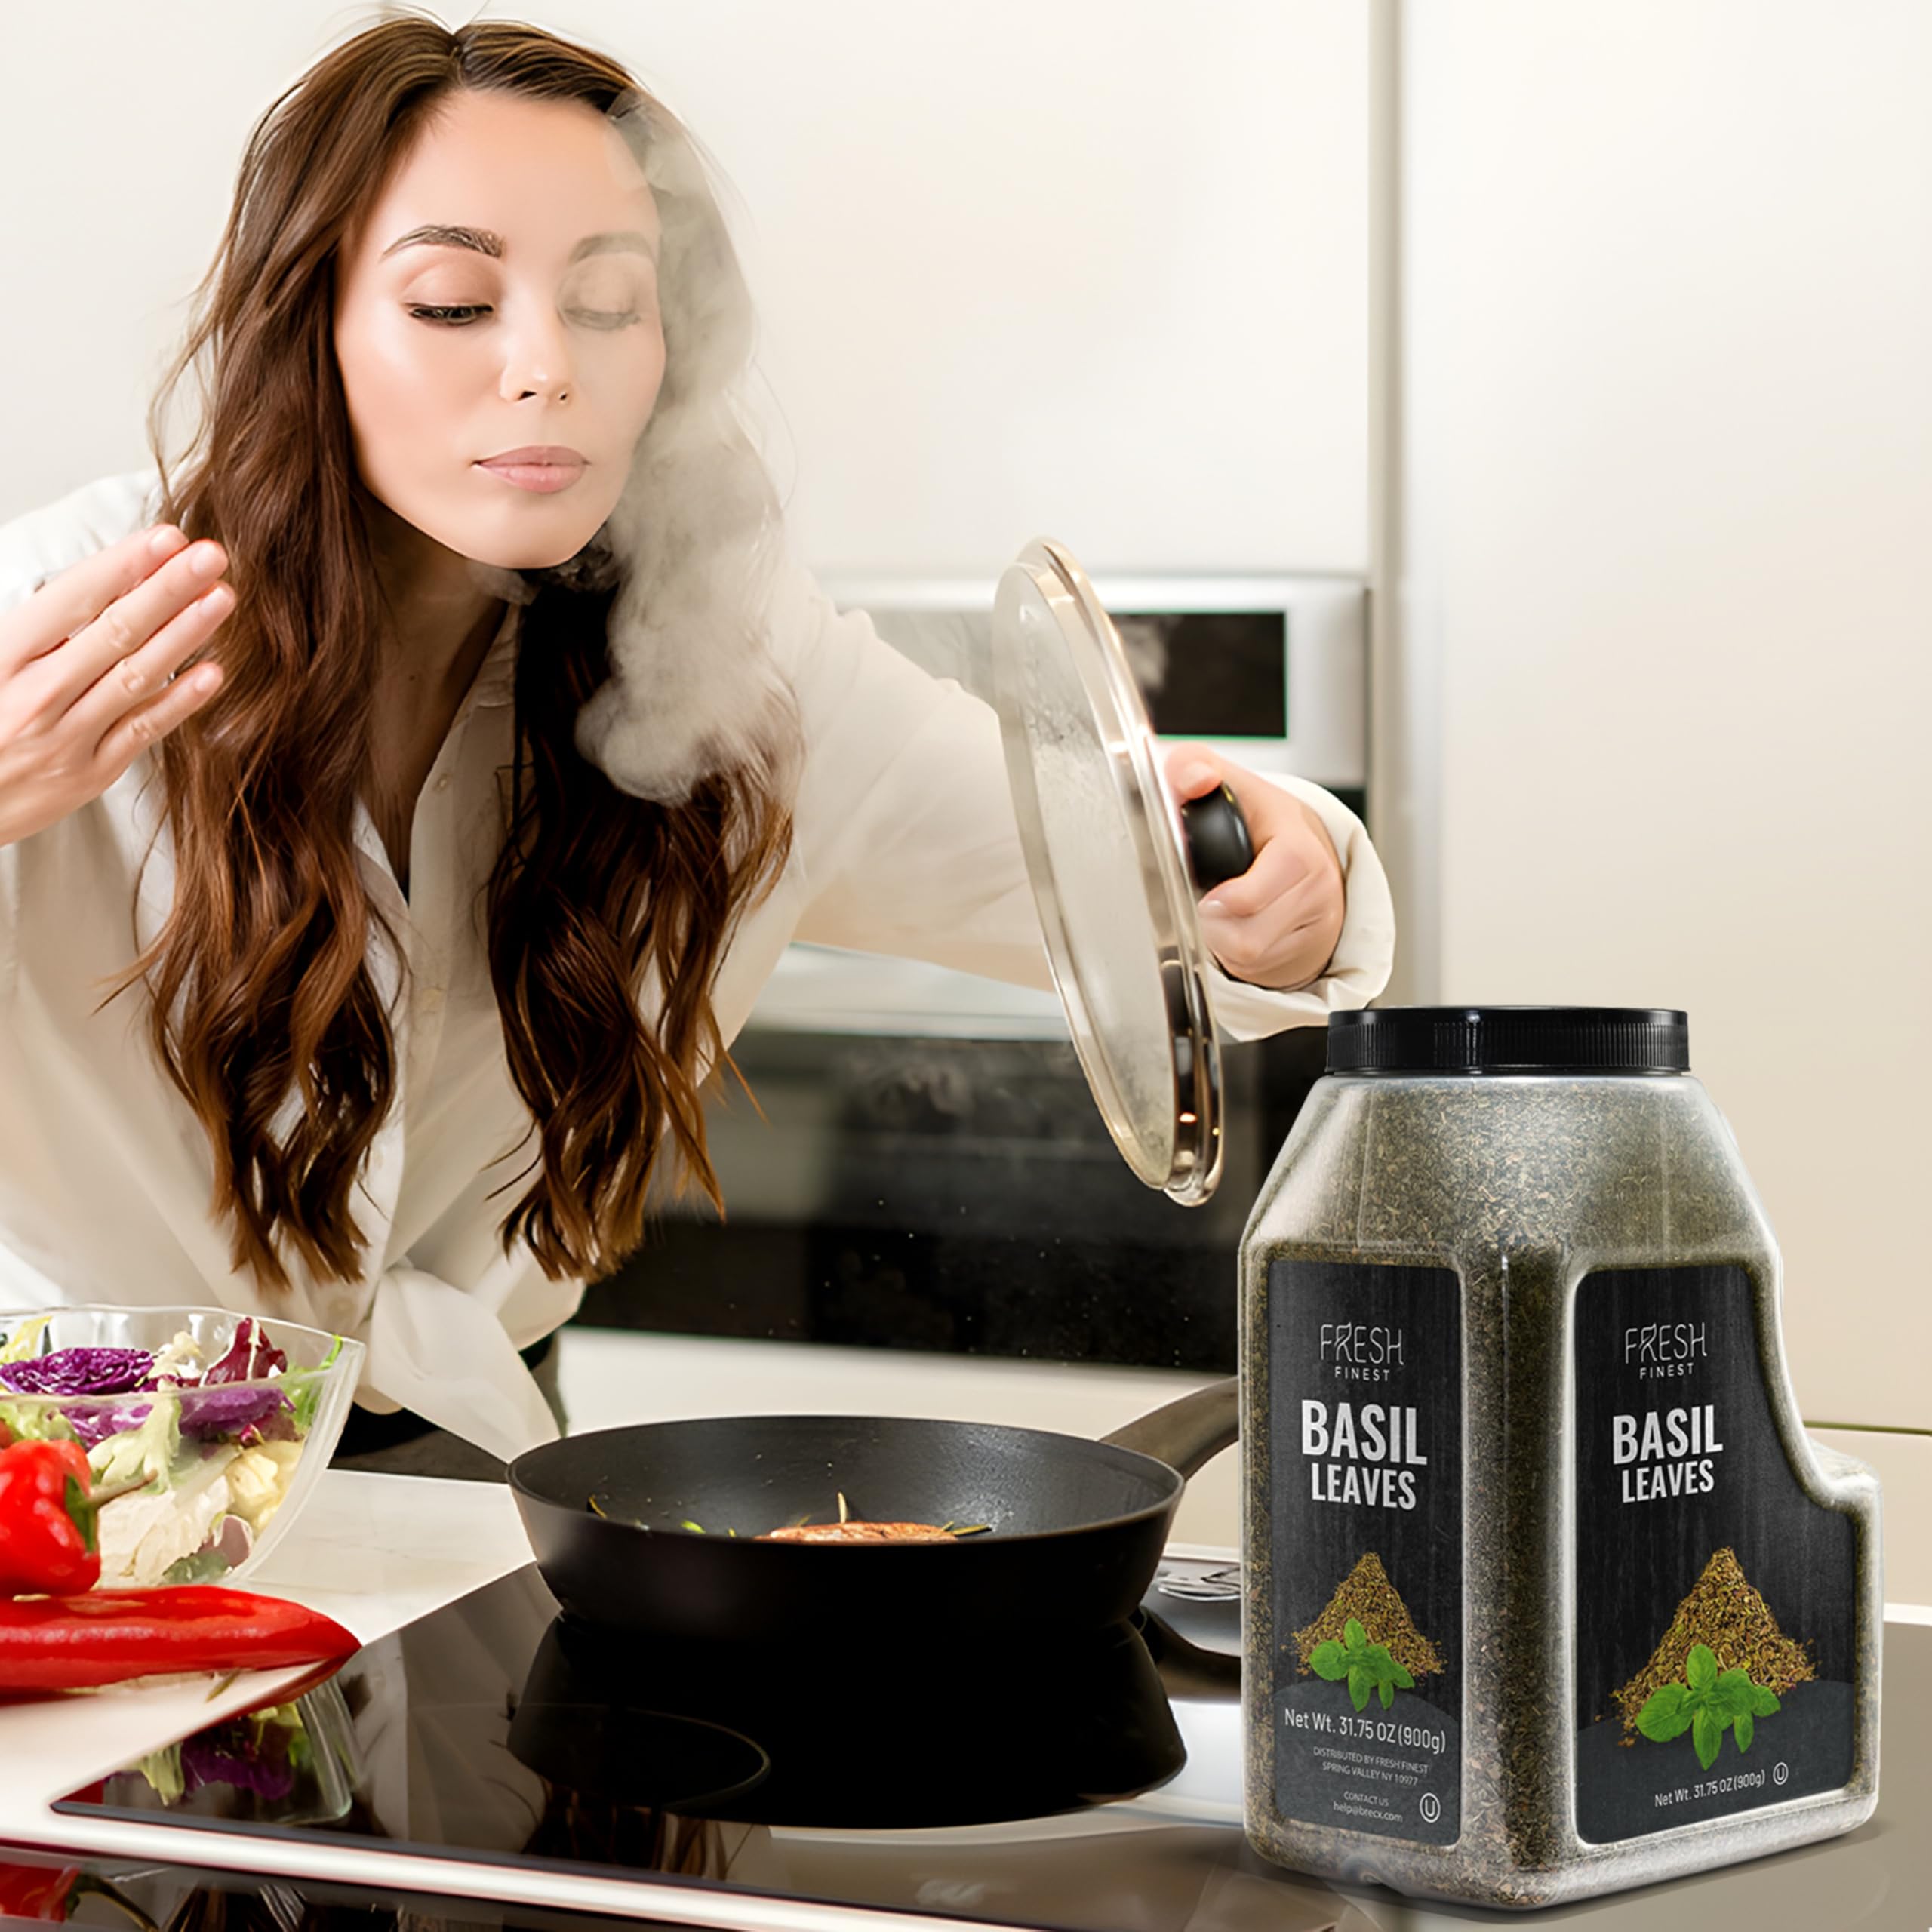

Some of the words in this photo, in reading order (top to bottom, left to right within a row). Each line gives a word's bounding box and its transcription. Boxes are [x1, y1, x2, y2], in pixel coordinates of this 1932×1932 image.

[1321, 1322, 1404, 1365] FRESH
[1625, 1322, 1707, 1364] FRESH
[1334, 1366, 1390, 1381] FINEST
[1639, 1362, 1694, 1380] FINEST
[1301, 1399, 1427, 1465] BASIL
[1613, 1404, 1724, 1465] BASIL
[1312, 1463, 1416, 1510] LEAVES
[1623, 1459, 1715, 1503] LEAVES
[1284, 1708, 1309, 1729] Net
[1312, 1712, 1336, 1733] Wt.
[1339, 1716, 1374, 1739] 31.75
[1398, 1724, 1445, 1755] (900g)
[1313, 1746, 1363, 1763] DISTRIBUTED
[1364, 1755, 1374, 1764] BY
[1375, 1756, 1400, 1770] FRESH
[1401, 1761, 1429, 1774] FINEST
[1322, 1761, 1350, 1774] SPRING
[1352, 1767, 1380, 1779] VALLEY
[1382, 1772, 1393, 1781] NY
[1395, 1774, 1418, 1786] 10977
[1343, 1790, 1378, 1805] CONTACT
[1379, 1798, 1389, 1807] US
[1654, 1793, 1672, 1807] Net
[1675, 1788, 1692, 1802] Wt.
[1694, 1780, 1718, 1799] 31.75
[1734, 1769, 1765, 1791] (900g)
